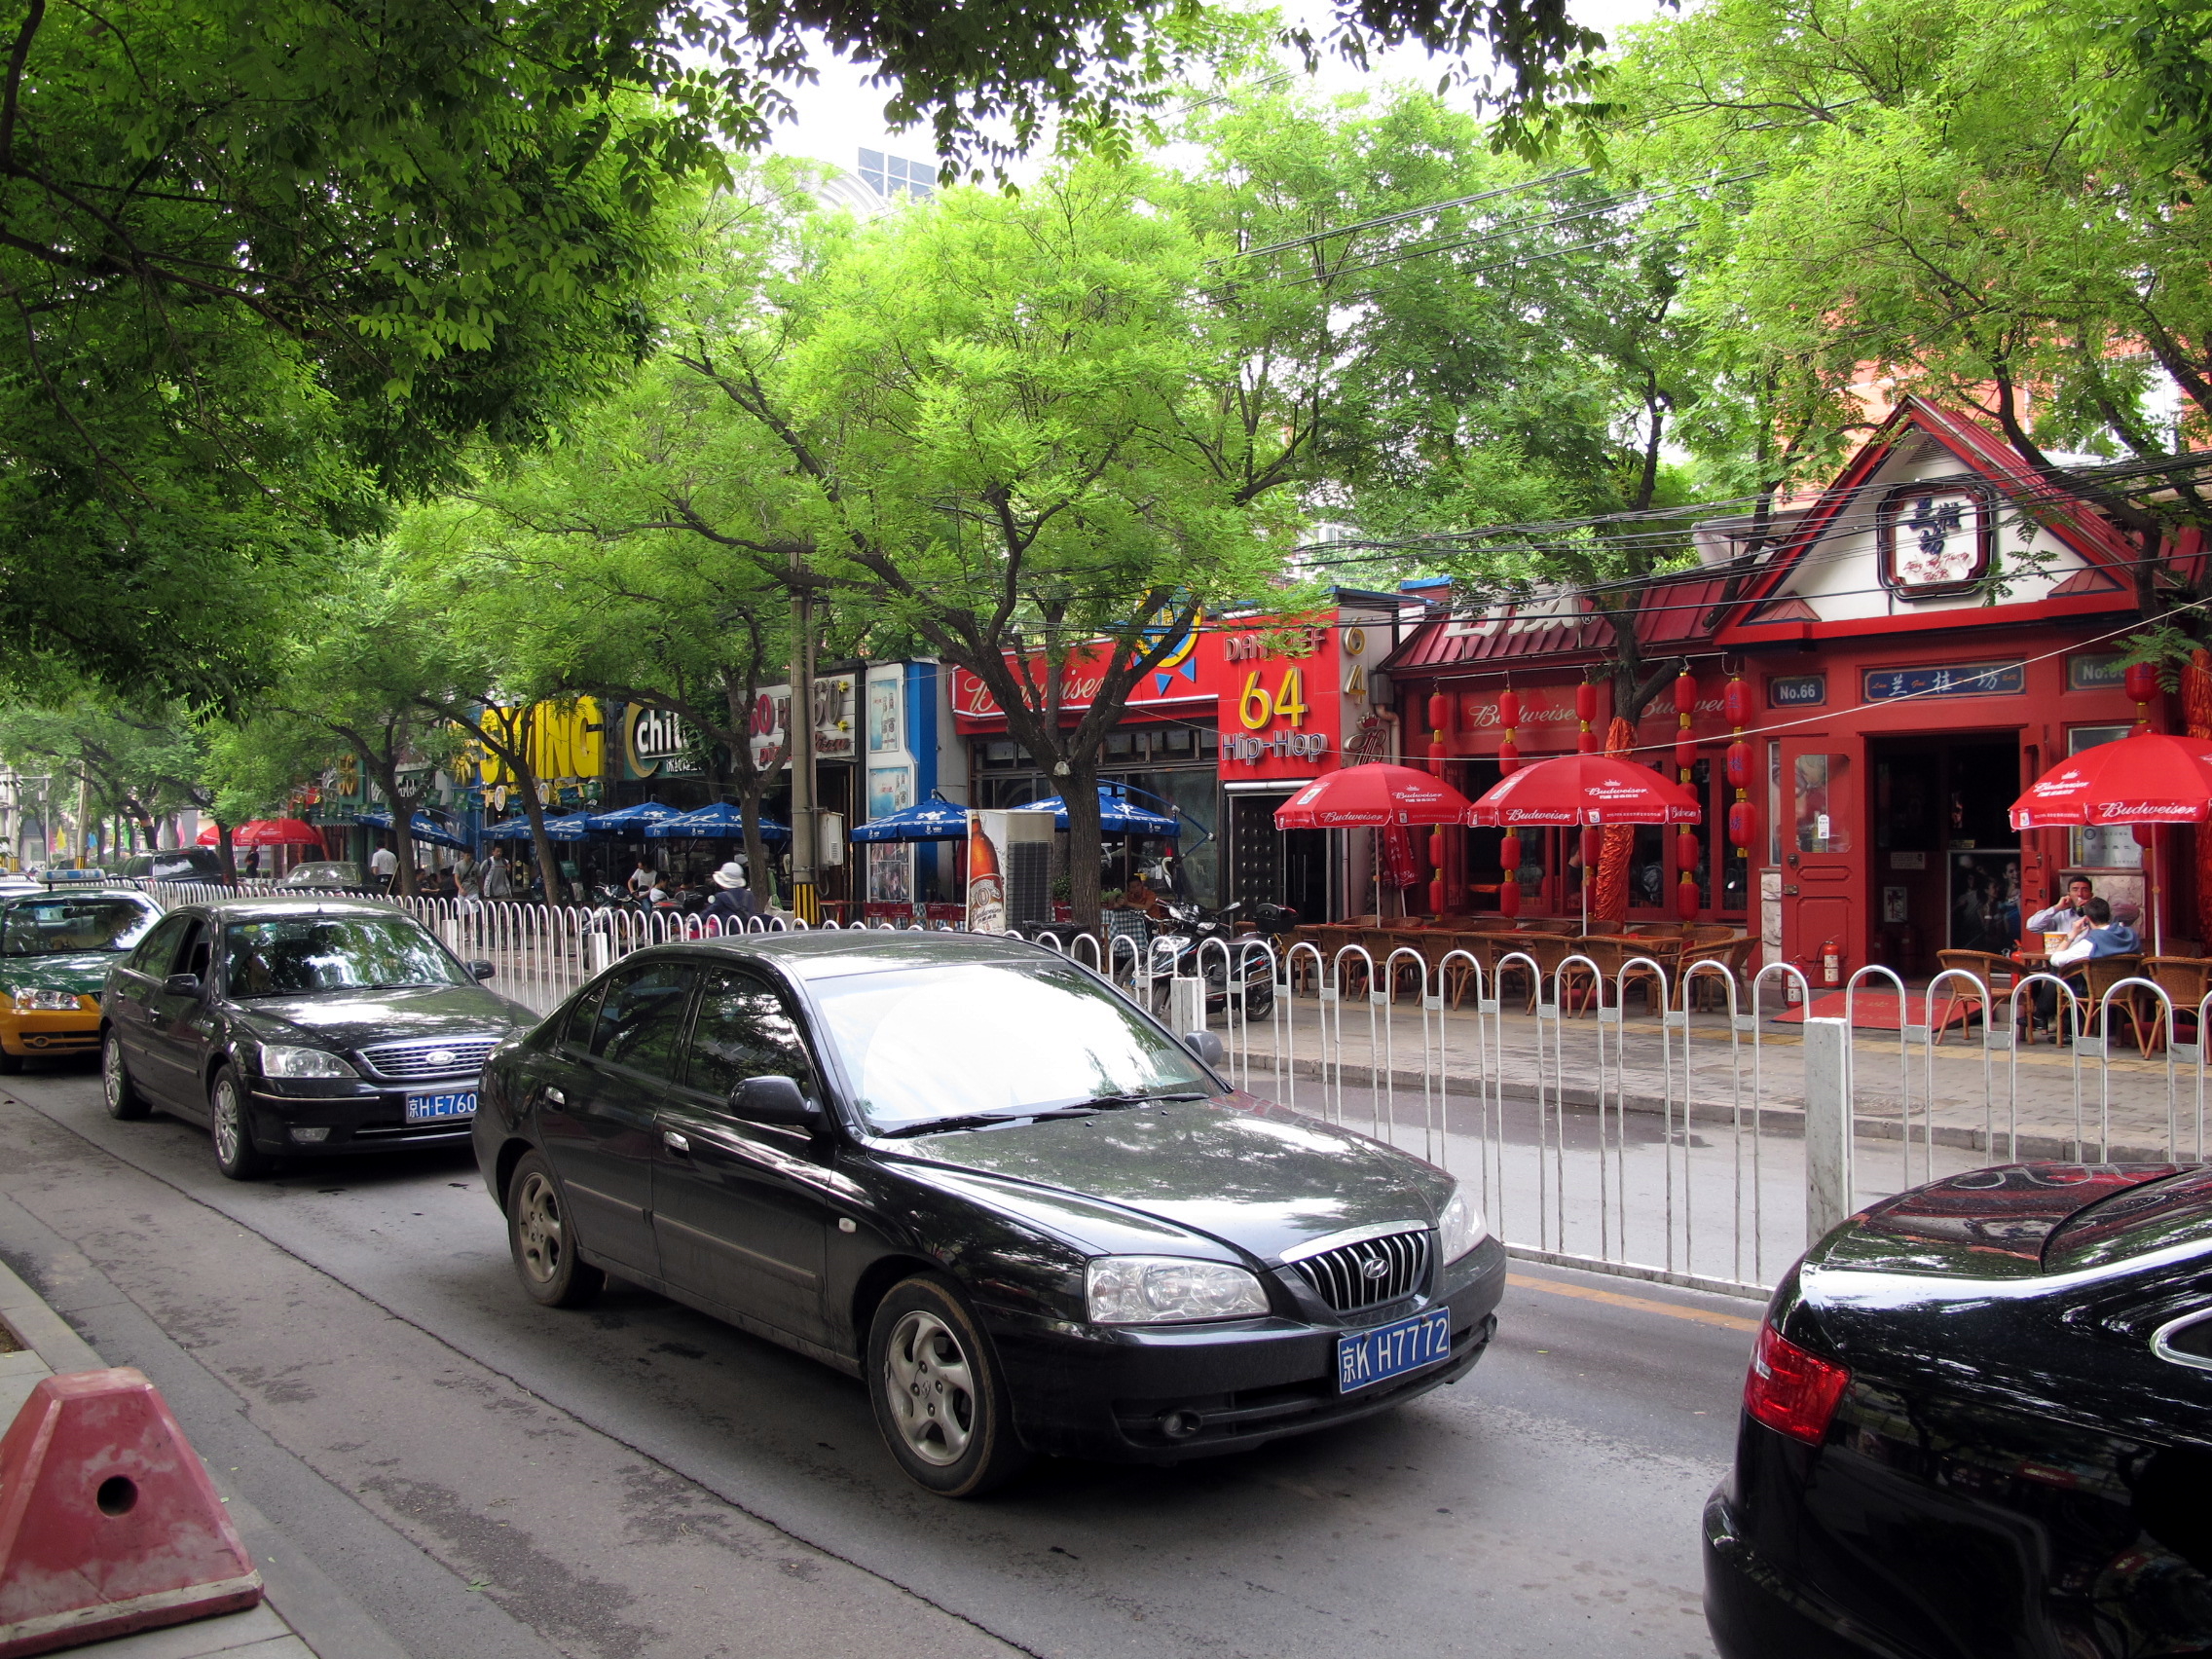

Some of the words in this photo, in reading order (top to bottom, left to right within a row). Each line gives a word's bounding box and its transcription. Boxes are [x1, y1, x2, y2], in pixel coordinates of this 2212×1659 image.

[1239, 667, 1309, 729] 64
[1780, 684, 1816, 700] No.66
[1222, 730, 1328, 765] Hip-Hop
[1584, 787, 1648, 795] Budweiser
[1320, 812, 1383, 823] Budweiser
[1505, 808, 1570, 822] Budweiser
[2098, 801, 2196, 818] Budweiser
